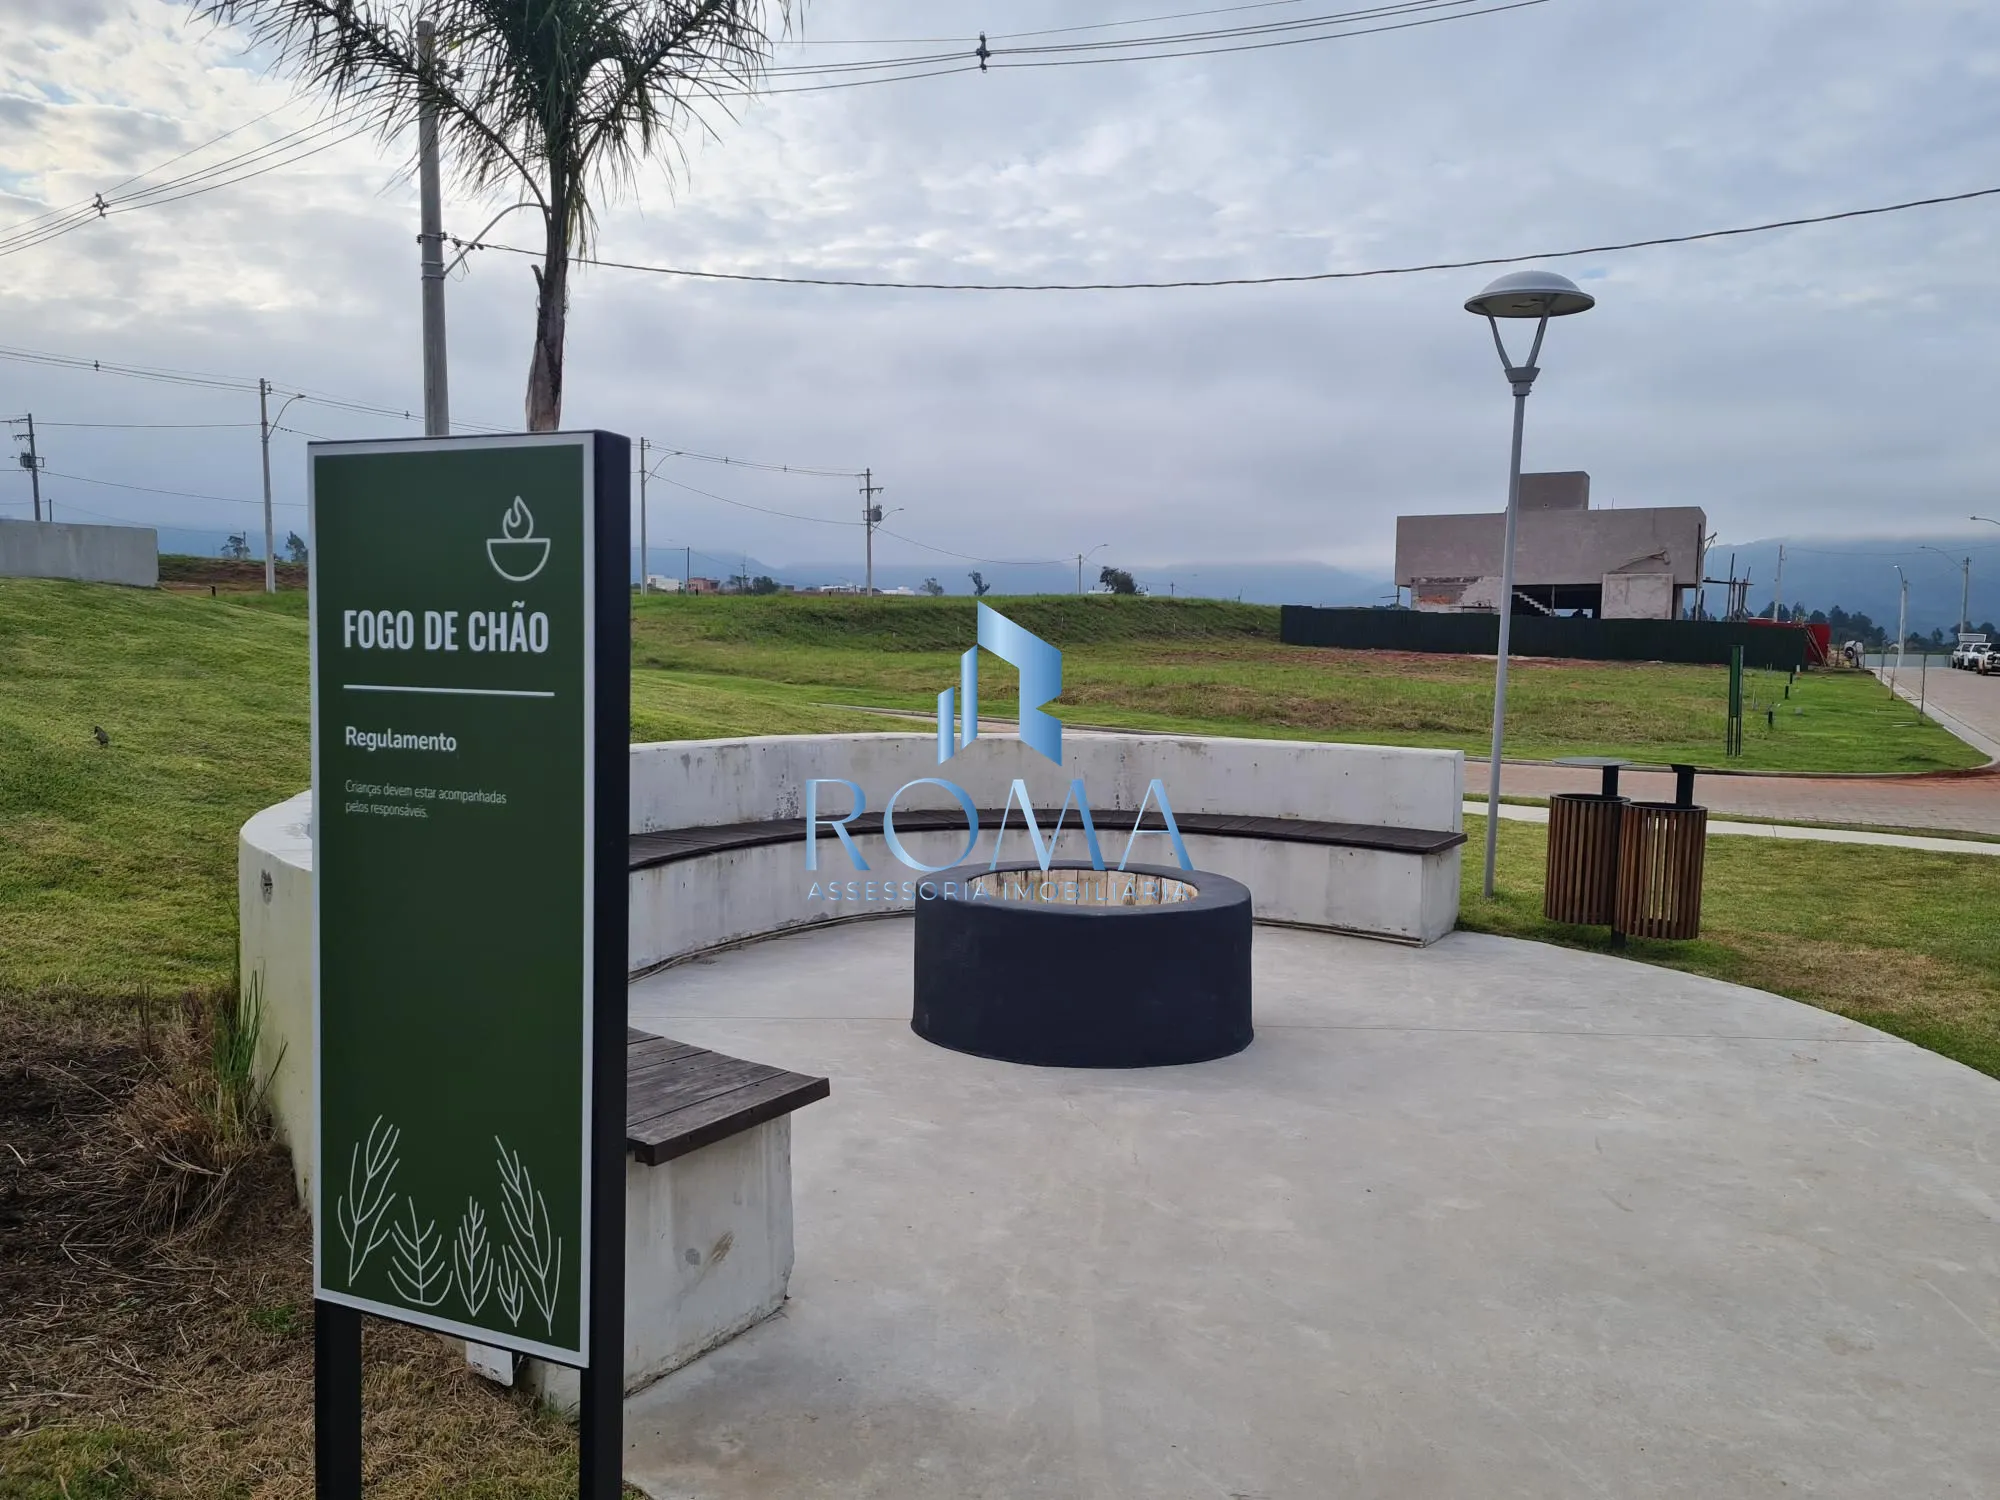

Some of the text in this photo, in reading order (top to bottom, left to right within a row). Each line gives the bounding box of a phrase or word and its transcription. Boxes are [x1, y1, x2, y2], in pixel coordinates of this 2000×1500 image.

[343, 601, 549, 653] FOGO DE CHÃO
[345, 726, 457, 752] Regulamento
[345, 779, 507, 804] Crianças devem estar acompanhadas
[345, 801, 429, 818] pelos responsáveis.
